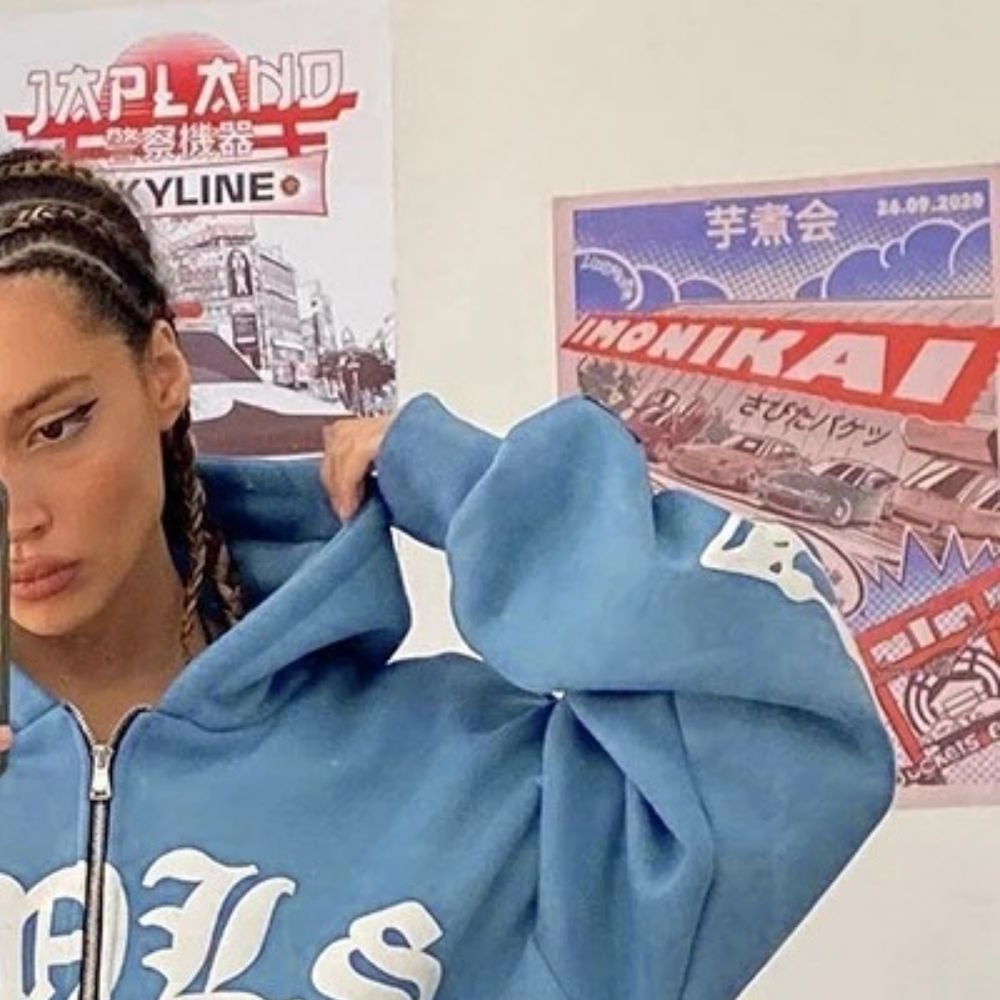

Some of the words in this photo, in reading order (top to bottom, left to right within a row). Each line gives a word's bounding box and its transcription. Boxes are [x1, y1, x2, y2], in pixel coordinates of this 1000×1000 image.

[27, 50, 344, 136] JAPLAND
[116, 171, 276, 211] KYLINE
[704, 198, 839, 249] 芋煮会
[572, 316, 977, 404] IMONIKAI
